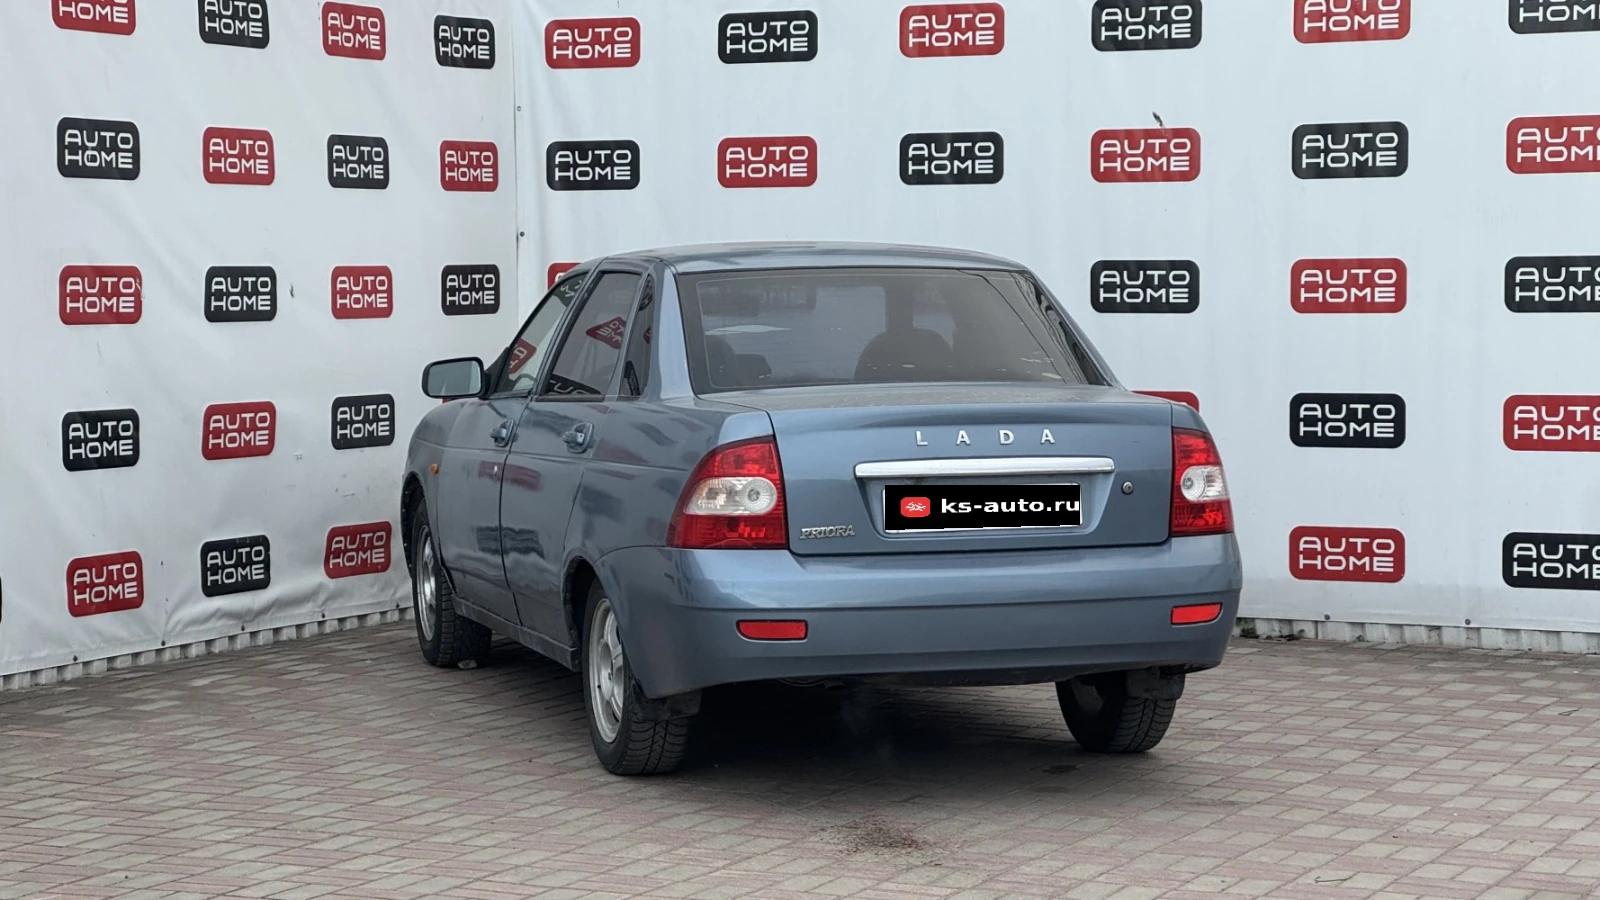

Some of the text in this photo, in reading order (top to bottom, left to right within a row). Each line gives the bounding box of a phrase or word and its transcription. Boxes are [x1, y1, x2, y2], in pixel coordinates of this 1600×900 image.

[59, 0, 128, 23] HOME
[205, 0, 262, 18] AUTO
[1102, 5, 1192, 23] AUTO
[1304, 0, 1400, 14] AUTO
[1519, 4, 1600, 22] HOM
[205, 16, 262, 37] HOME
[328, 13, 380, 32] AUTO
[727, 21, 809, 37] AUTO
[909, 13, 995, 30] AUTO
[1304, 13, 1399, 33] HOME
[328, 30, 380, 50] HOME
[439, 25, 489, 42] AUTO
[553, 27, 632, 42] AUTO
[909, 30, 994, 47] HOME
[1101, 23, 1191, 41] HOME
[439, 42, 489, 59] HOME
[553, 44, 631, 59] HOME
[727, 38, 807, 53] HOME
[65, 130, 133, 148] AUTO
[210, 138, 268, 156] AUTO
[1100, 139, 1191, 154] AUTO
[1302, 133, 1398, 150] AUTO
[333, 145, 383, 161] AUTO
[555, 150, 631, 164] AUTO
[726, 146, 808, 161] AUTO
[909, 142, 994, 157] AUTO
[65, 149, 132, 168] HOME
[210, 157, 268, 174] HOME
[445, 151, 493, 165] AUTO
[1100, 156, 1189, 172] HOME
[1302, 151, 1397, 168] HOME
[334, 163, 384, 178] HOME
[446, 167, 493, 181] HOME
[555, 166, 630, 181] HOME
[726, 163, 807, 178] HOME
[909, 159, 993, 174] HOME
[212, 277, 271, 292] AUTO
[337, 276, 387, 290] AUTO
[447, 274, 495, 288] AUTO
[1100, 271, 1190, 285] AUTO
[1301, 269, 1396, 284] AUTO
[67, 277, 135, 293] AUTO
[337, 293, 387, 308] HOME
[447, 291, 494, 305] HOME
[1100, 288, 1188, 302] HOME
[1301, 287, 1395, 302] HOME
[67, 297, 134, 312] HOME
[211, 295, 270, 311] HOME
[338, 404, 389, 421] AUTO
[1300, 404, 1395, 419] AUTO
[210, 412, 270, 430] AUTO
[69, 421, 133, 439] AUTO
[337, 421, 389, 439] HOME
[915, 428, 1056, 447] LADA
[1300, 422, 1394, 437] HOME
[209, 430, 268, 448] HOME
[70, 440, 132, 459] HOME
[799, 524, 855, 540] PRIORA
[331, 531, 387, 551] AUTO
[1300, 537, 1395, 553] AUTO
[208, 546, 264, 567] AUTO
[329, 548, 385, 568] HOME
[1300, 555, 1393, 572] HOME
[74, 563, 136, 585] AUTO
[208, 564, 264, 585] HOME
[74, 582, 137, 605] HOME
